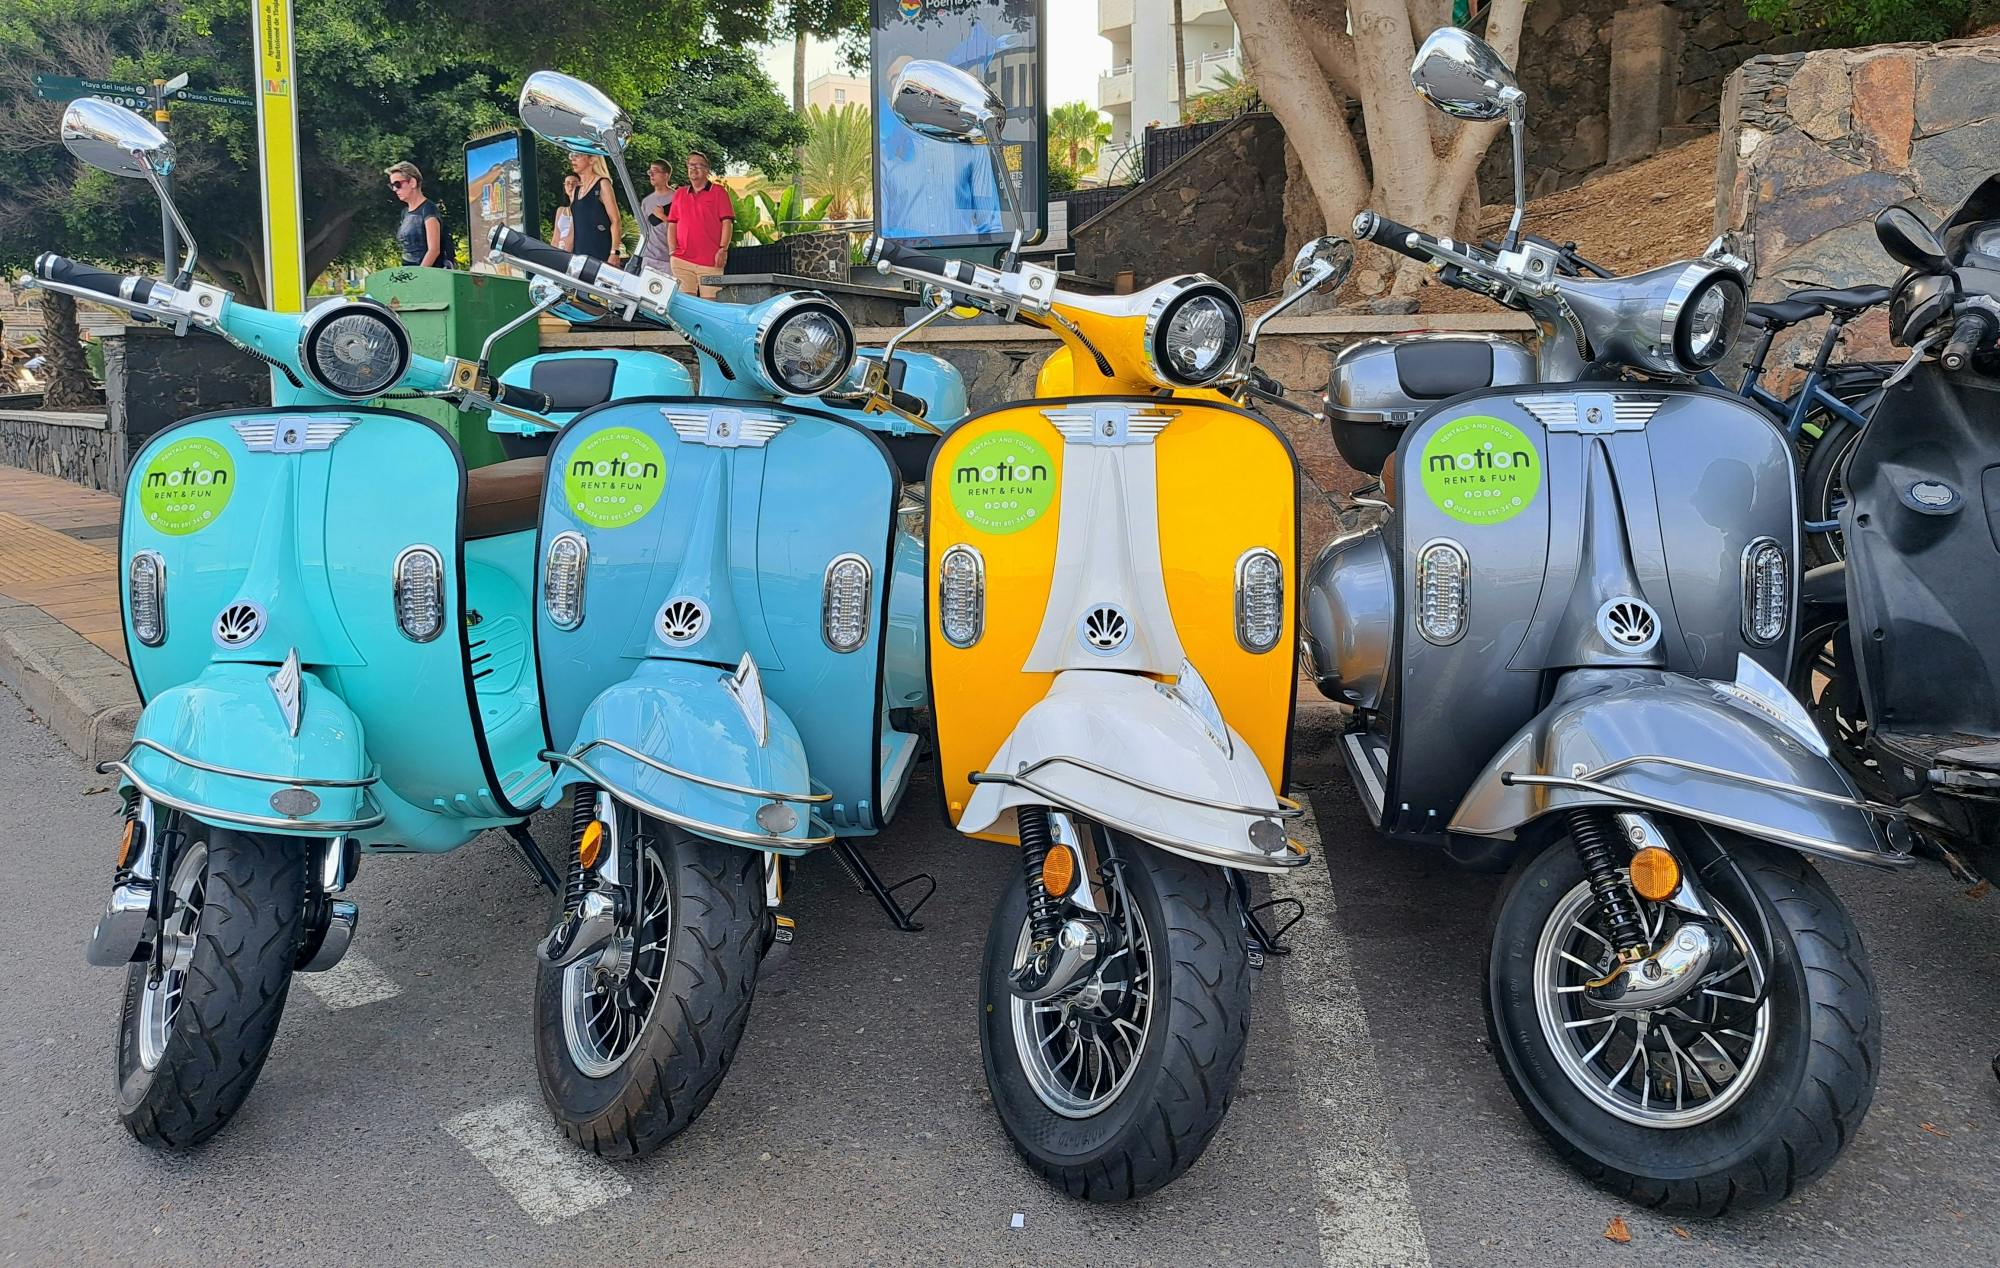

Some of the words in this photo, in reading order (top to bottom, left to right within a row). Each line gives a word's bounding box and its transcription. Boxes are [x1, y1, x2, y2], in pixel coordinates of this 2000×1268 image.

[266, 14, 274, 58] Ayuntamiento
[81, 80, 100, 89] Playa
[114, 84, 135, 93] Inglés
[229, 98, 253, 106] Canaria
[1441, 425, 1469, 443] RENTALS
[1491, 425, 1513, 440] TOURS
[204, 446, 220, 459] TOURS
[969, 438, 996, 456] RENTALS
[1016, 439, 1035, 454] TOURS
[573, 452, 658, 478] motion
[1430, 442, 1529, 472] motion
[148, 461, 227, 487] motion
[958, 456, 1046, 483] motion
[1444, 476, 1475, 485] RENT
[155, 491, 178, 499] RENT
[968, 488, 996, 496] RENT
